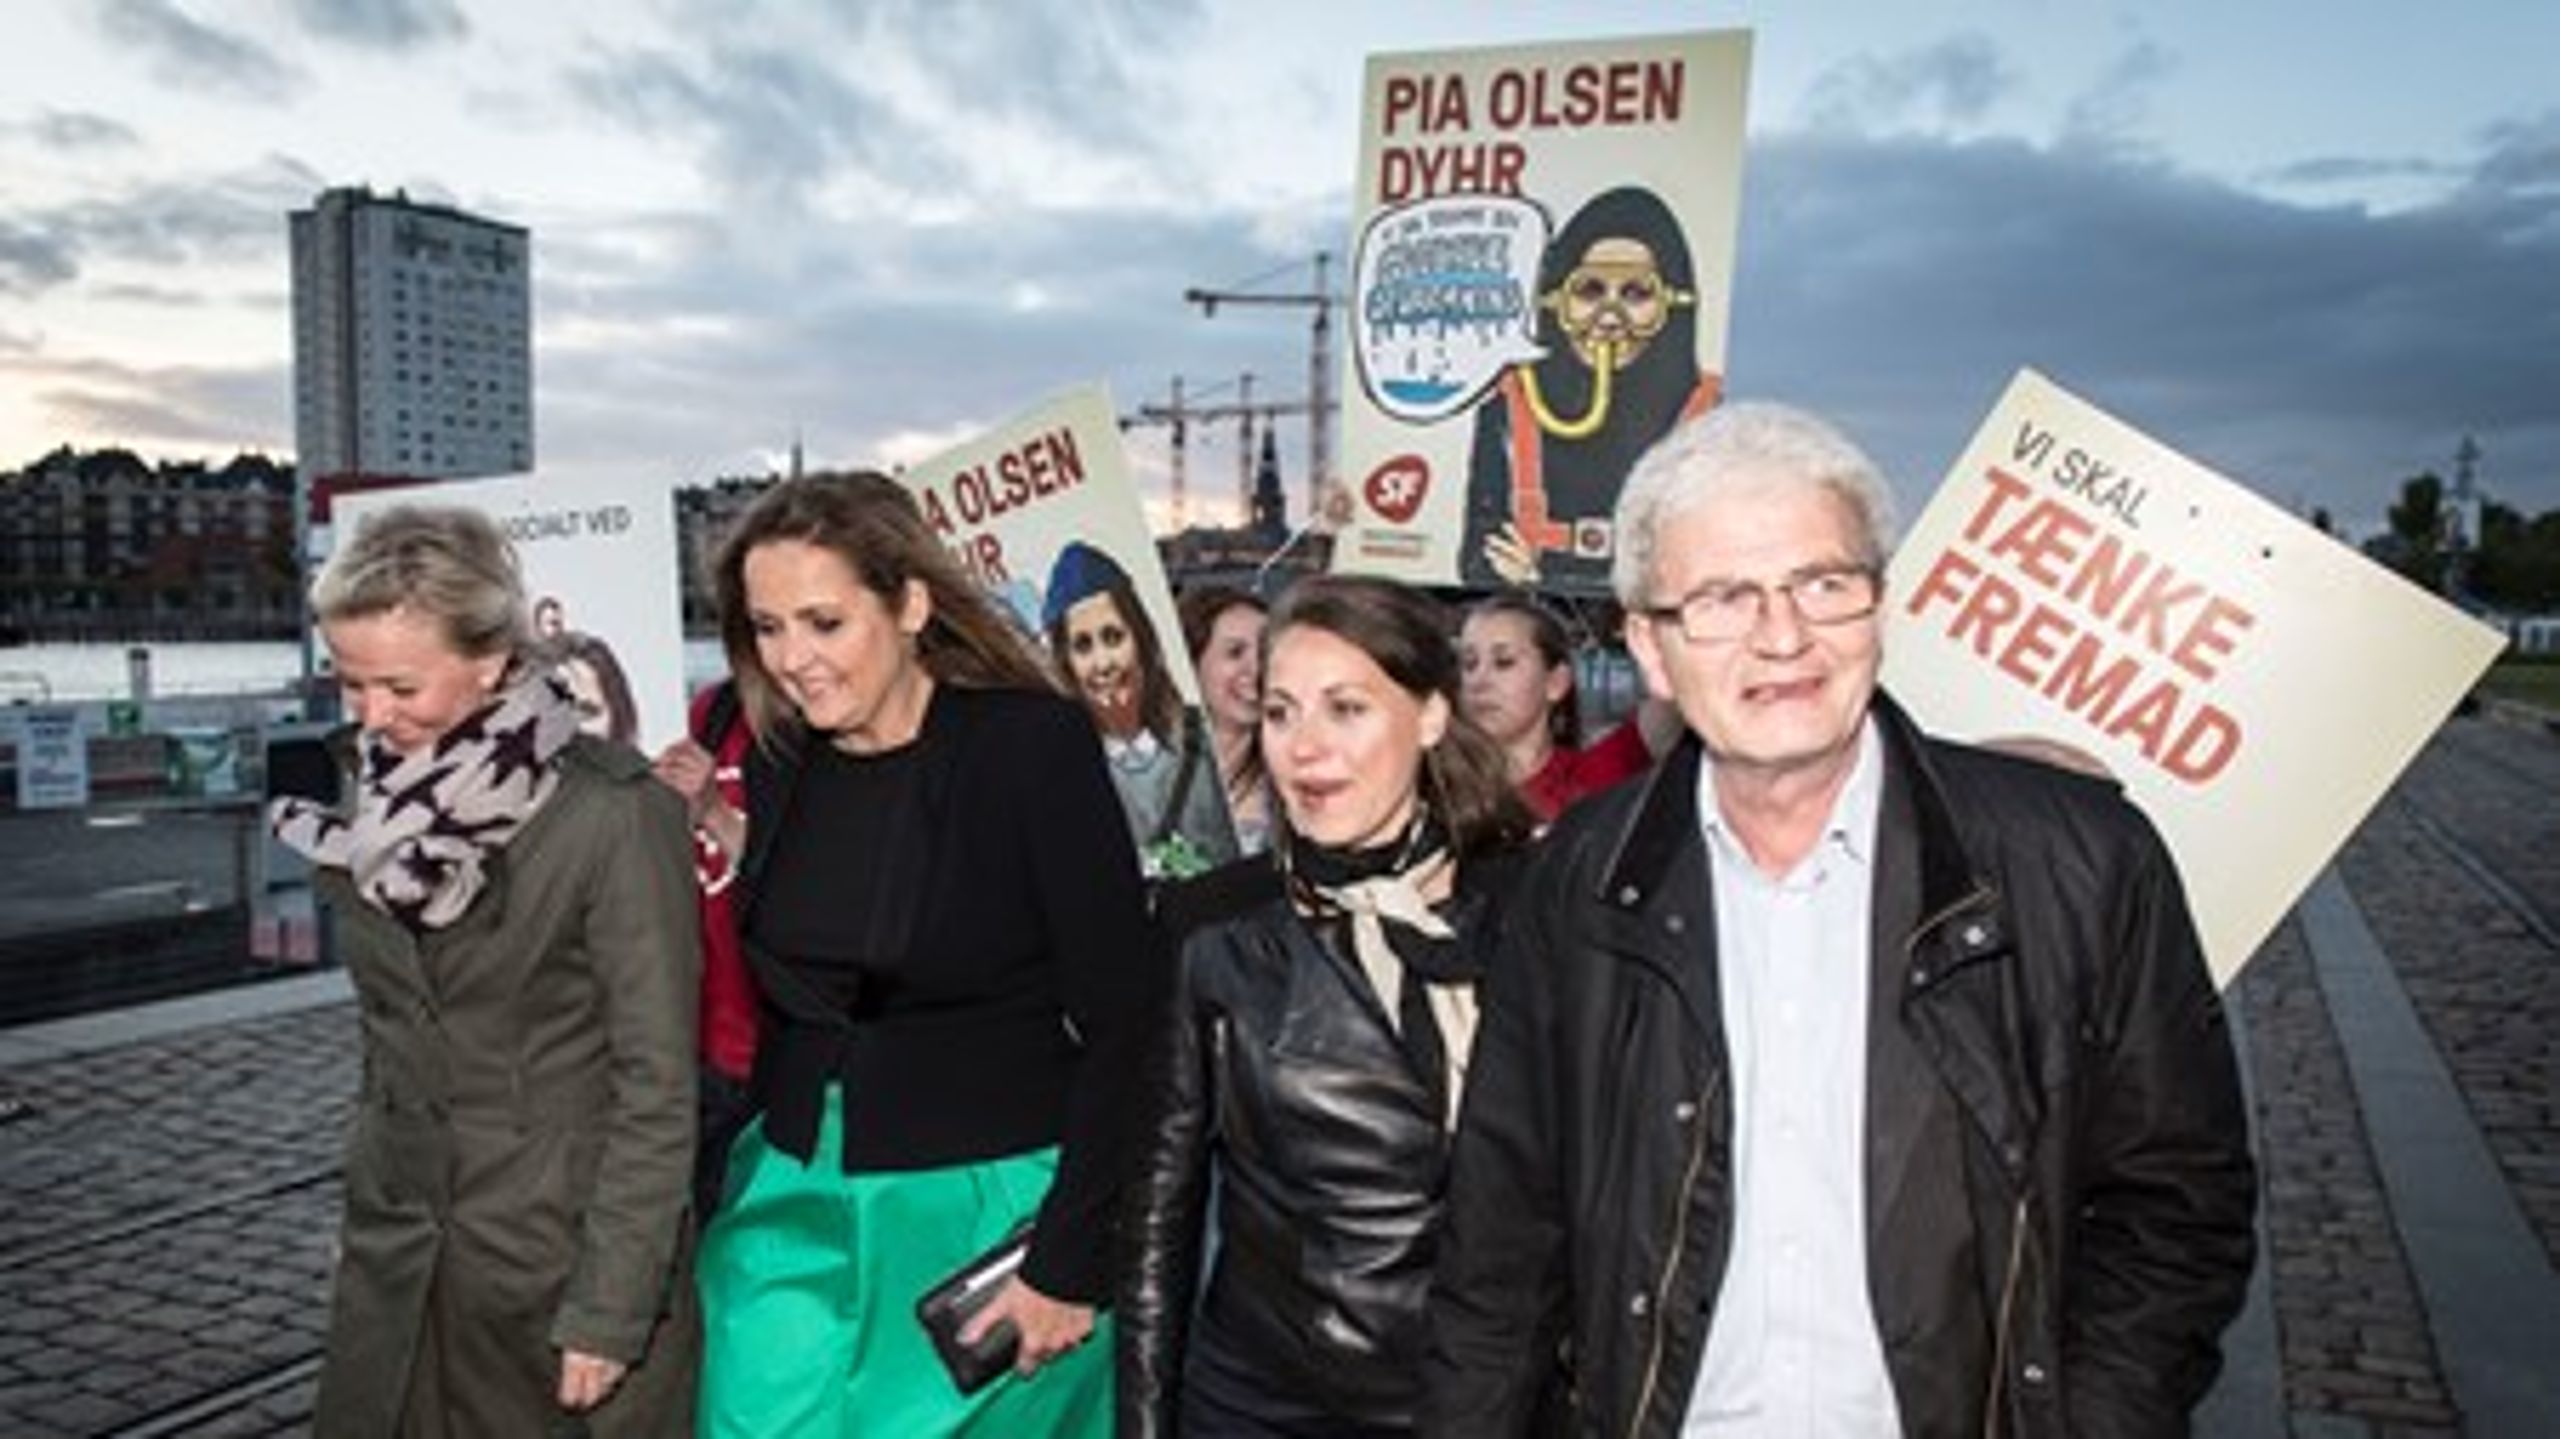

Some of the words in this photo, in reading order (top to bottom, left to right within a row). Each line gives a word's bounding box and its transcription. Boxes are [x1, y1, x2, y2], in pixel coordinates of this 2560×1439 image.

[1382, 73, 1469, 135] PIA
[1489, 60, 1684, 131] OLSEN
[1380, 141, 1527, 203] DYHR
[953, 428, 1084, 525] OLSEN
[1375, 469, 1423, 506] SF
[2011, 421, 2055, 468] VI
[2053, 447, 2150, 530] SKAL
[586, 505, 632, 535] VED
[1962, 466, 2256, 684] TÆNKE
[1906, 549, 2242, 787] FREMAD
